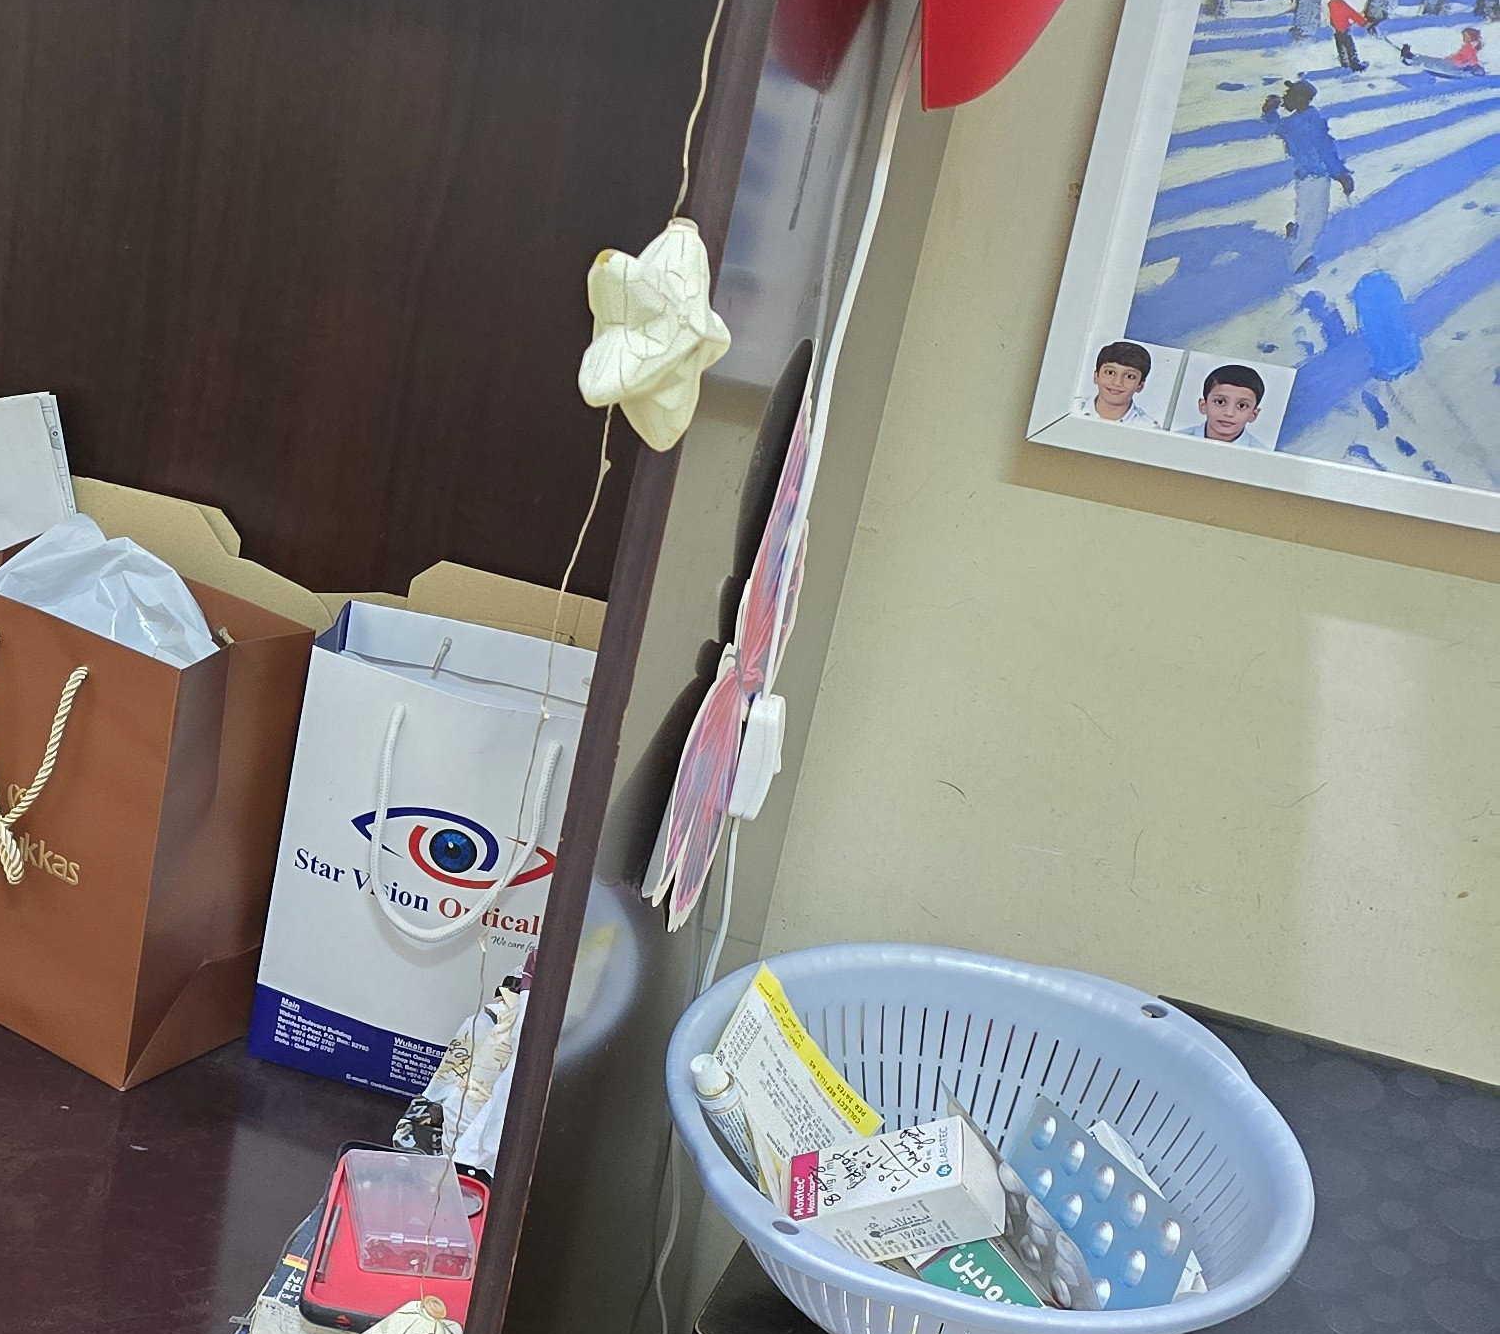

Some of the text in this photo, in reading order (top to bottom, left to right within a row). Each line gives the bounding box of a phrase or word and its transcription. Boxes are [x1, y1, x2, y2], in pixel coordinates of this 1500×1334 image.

[294, 847, 540, 936] Star Vion Otical
[491, 935, 506, 947] We
[507, 940, 526, 951] care
[280, 997, 300, 1011] Main
[393, 1036, 424, 1052] Wukair
[816, 1070, 837, 1098] REFILLS
[836, 1083, 867, 1117] PER DATES
[837, 1098, 861, 1124] COLLECT
[939, 1127, 949, 1163] LABATEC
[949, 1252, 1016, 1305] ودين
